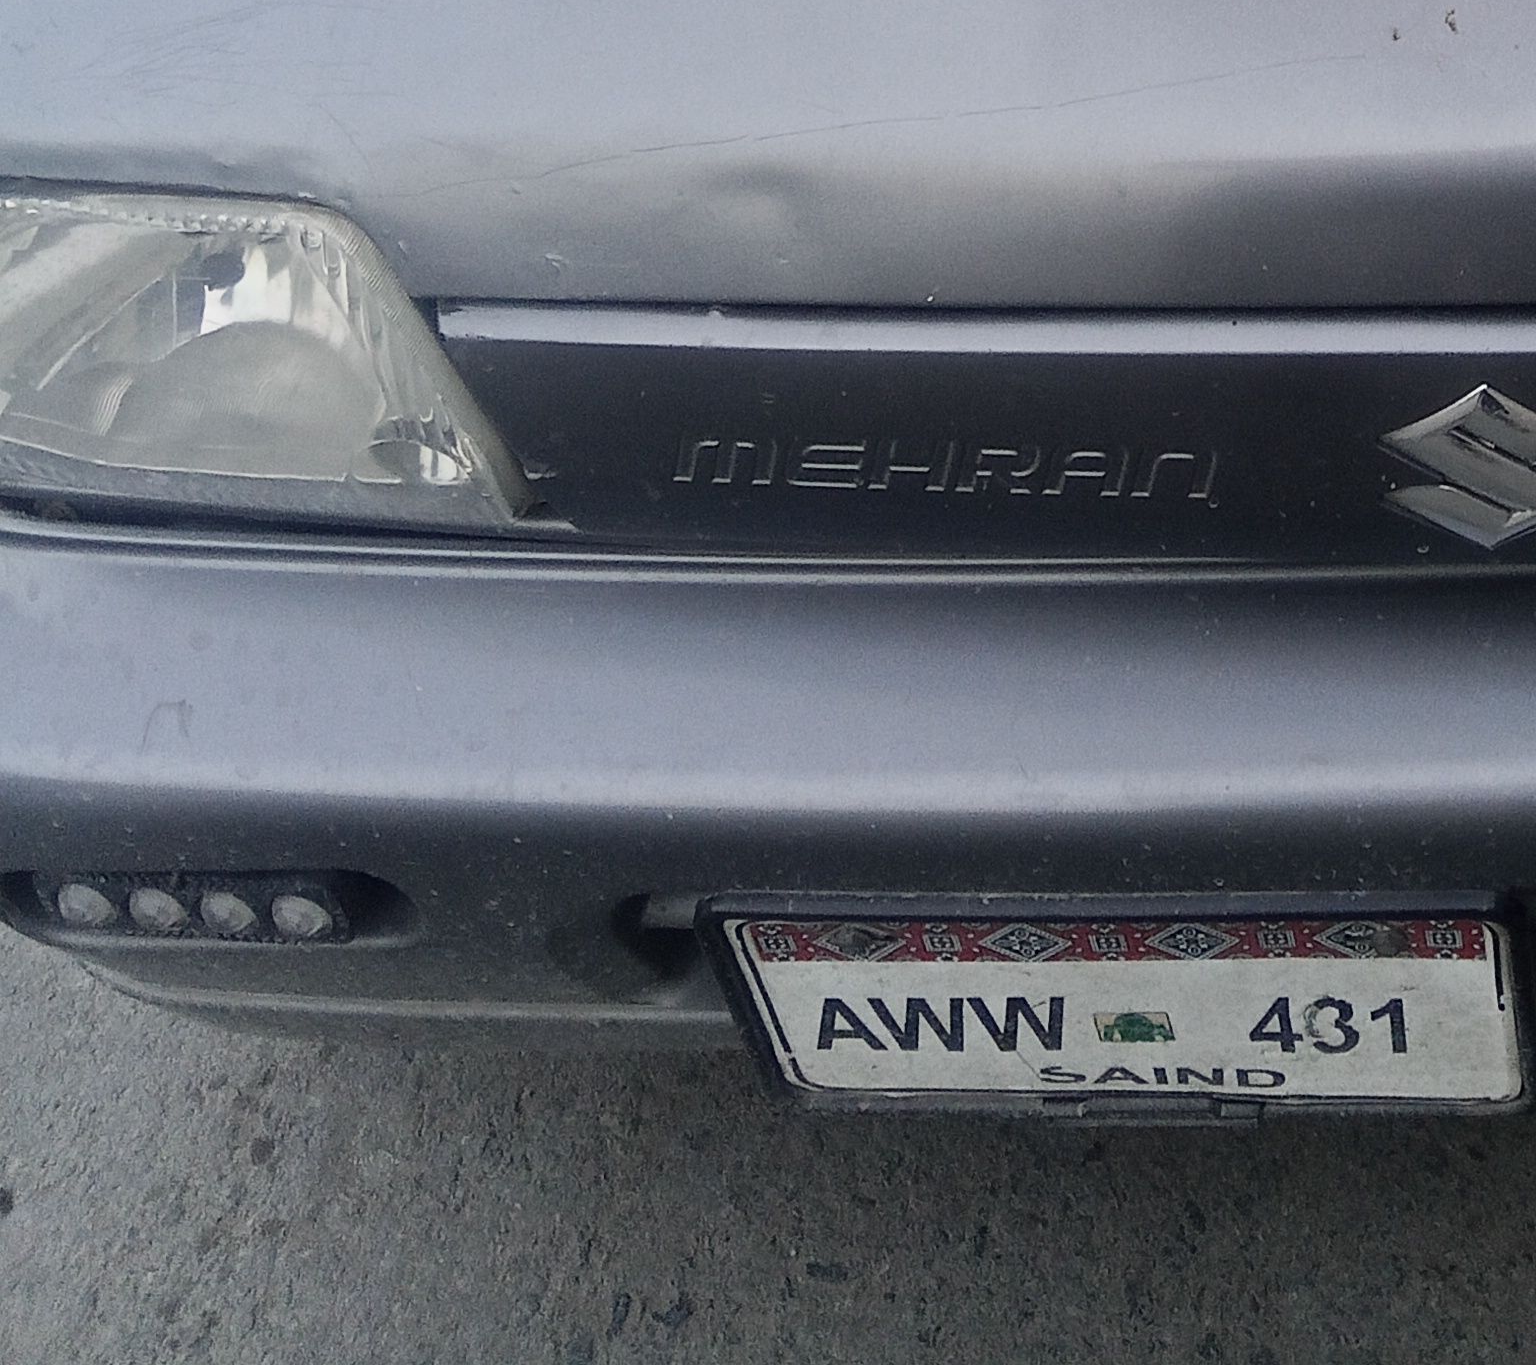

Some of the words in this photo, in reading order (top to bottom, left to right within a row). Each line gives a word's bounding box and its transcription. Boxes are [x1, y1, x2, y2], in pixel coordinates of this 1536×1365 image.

[672, 439, 1218, 499] MEHRAN
[815, 996, 1066, 1054] AWW
[1249, 997, 1410, 1055] 431
[1038, 1066, 1288, 1090] SAIND
